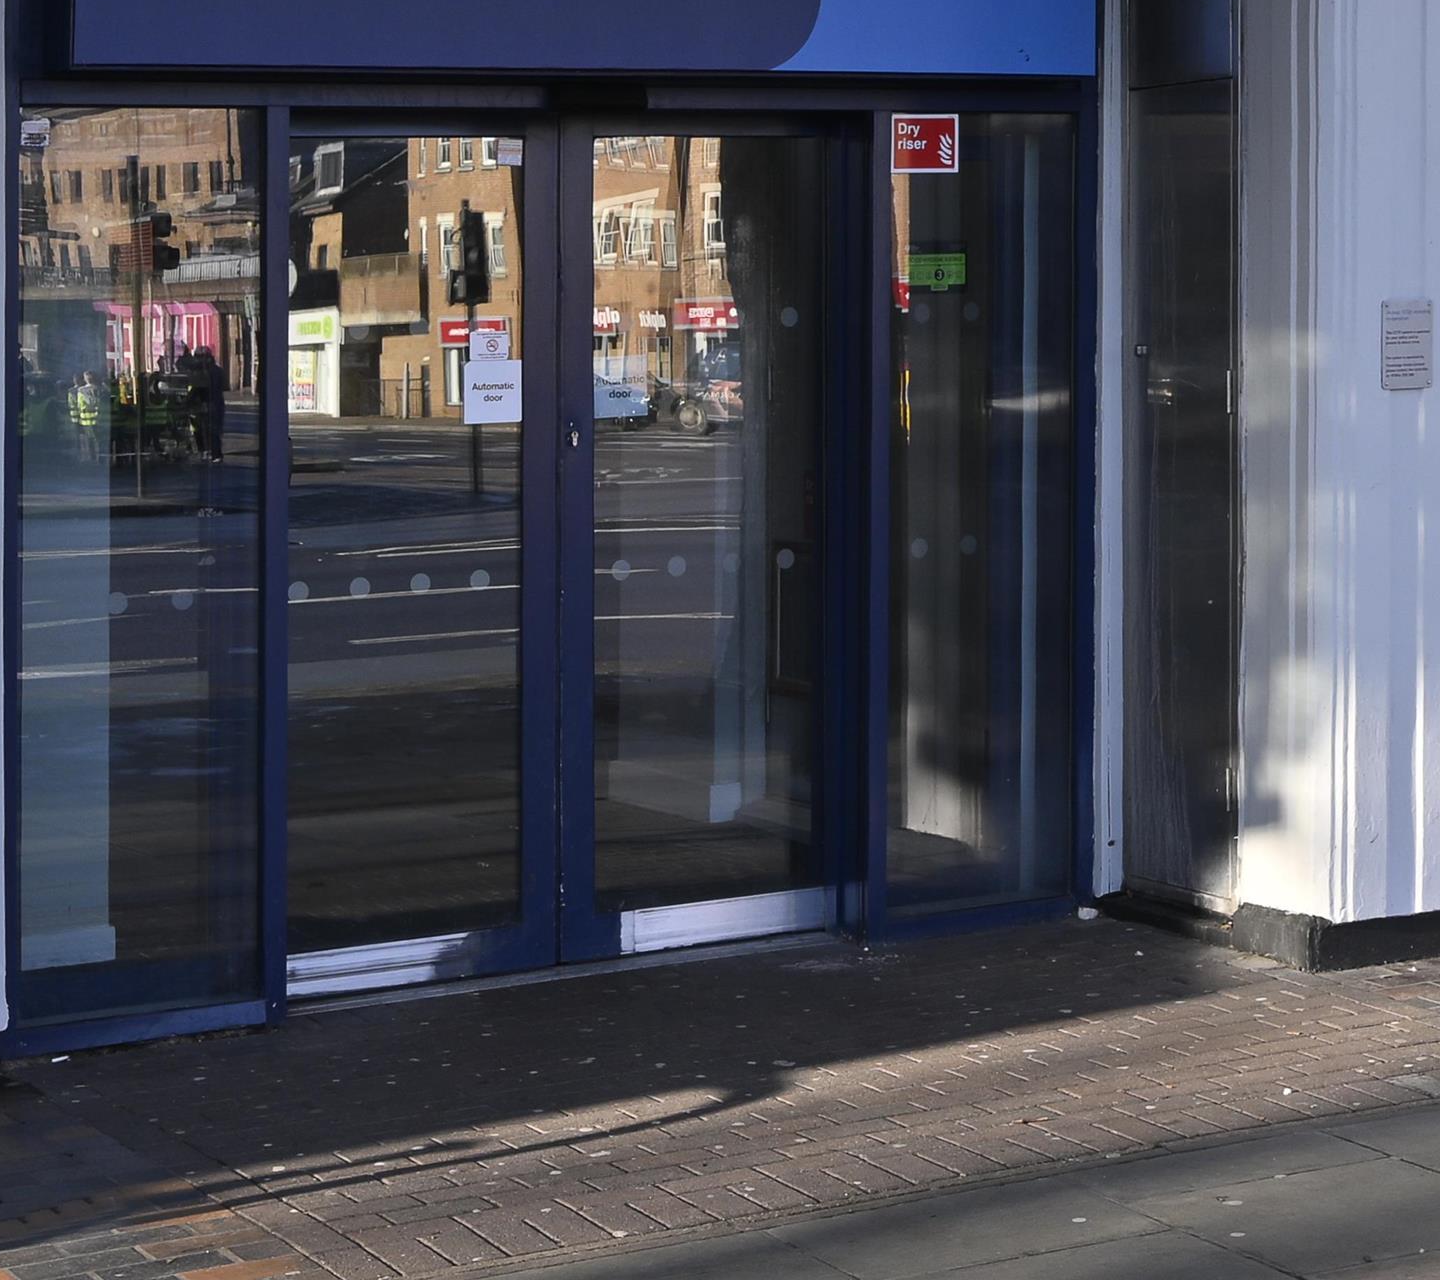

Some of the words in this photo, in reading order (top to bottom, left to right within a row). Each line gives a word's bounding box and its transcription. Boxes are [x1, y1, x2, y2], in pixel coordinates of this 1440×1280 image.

[898, 123, 920, 138] Dry
[898, 139, 927, 150] riser
[609, 390, 632, 398] door
